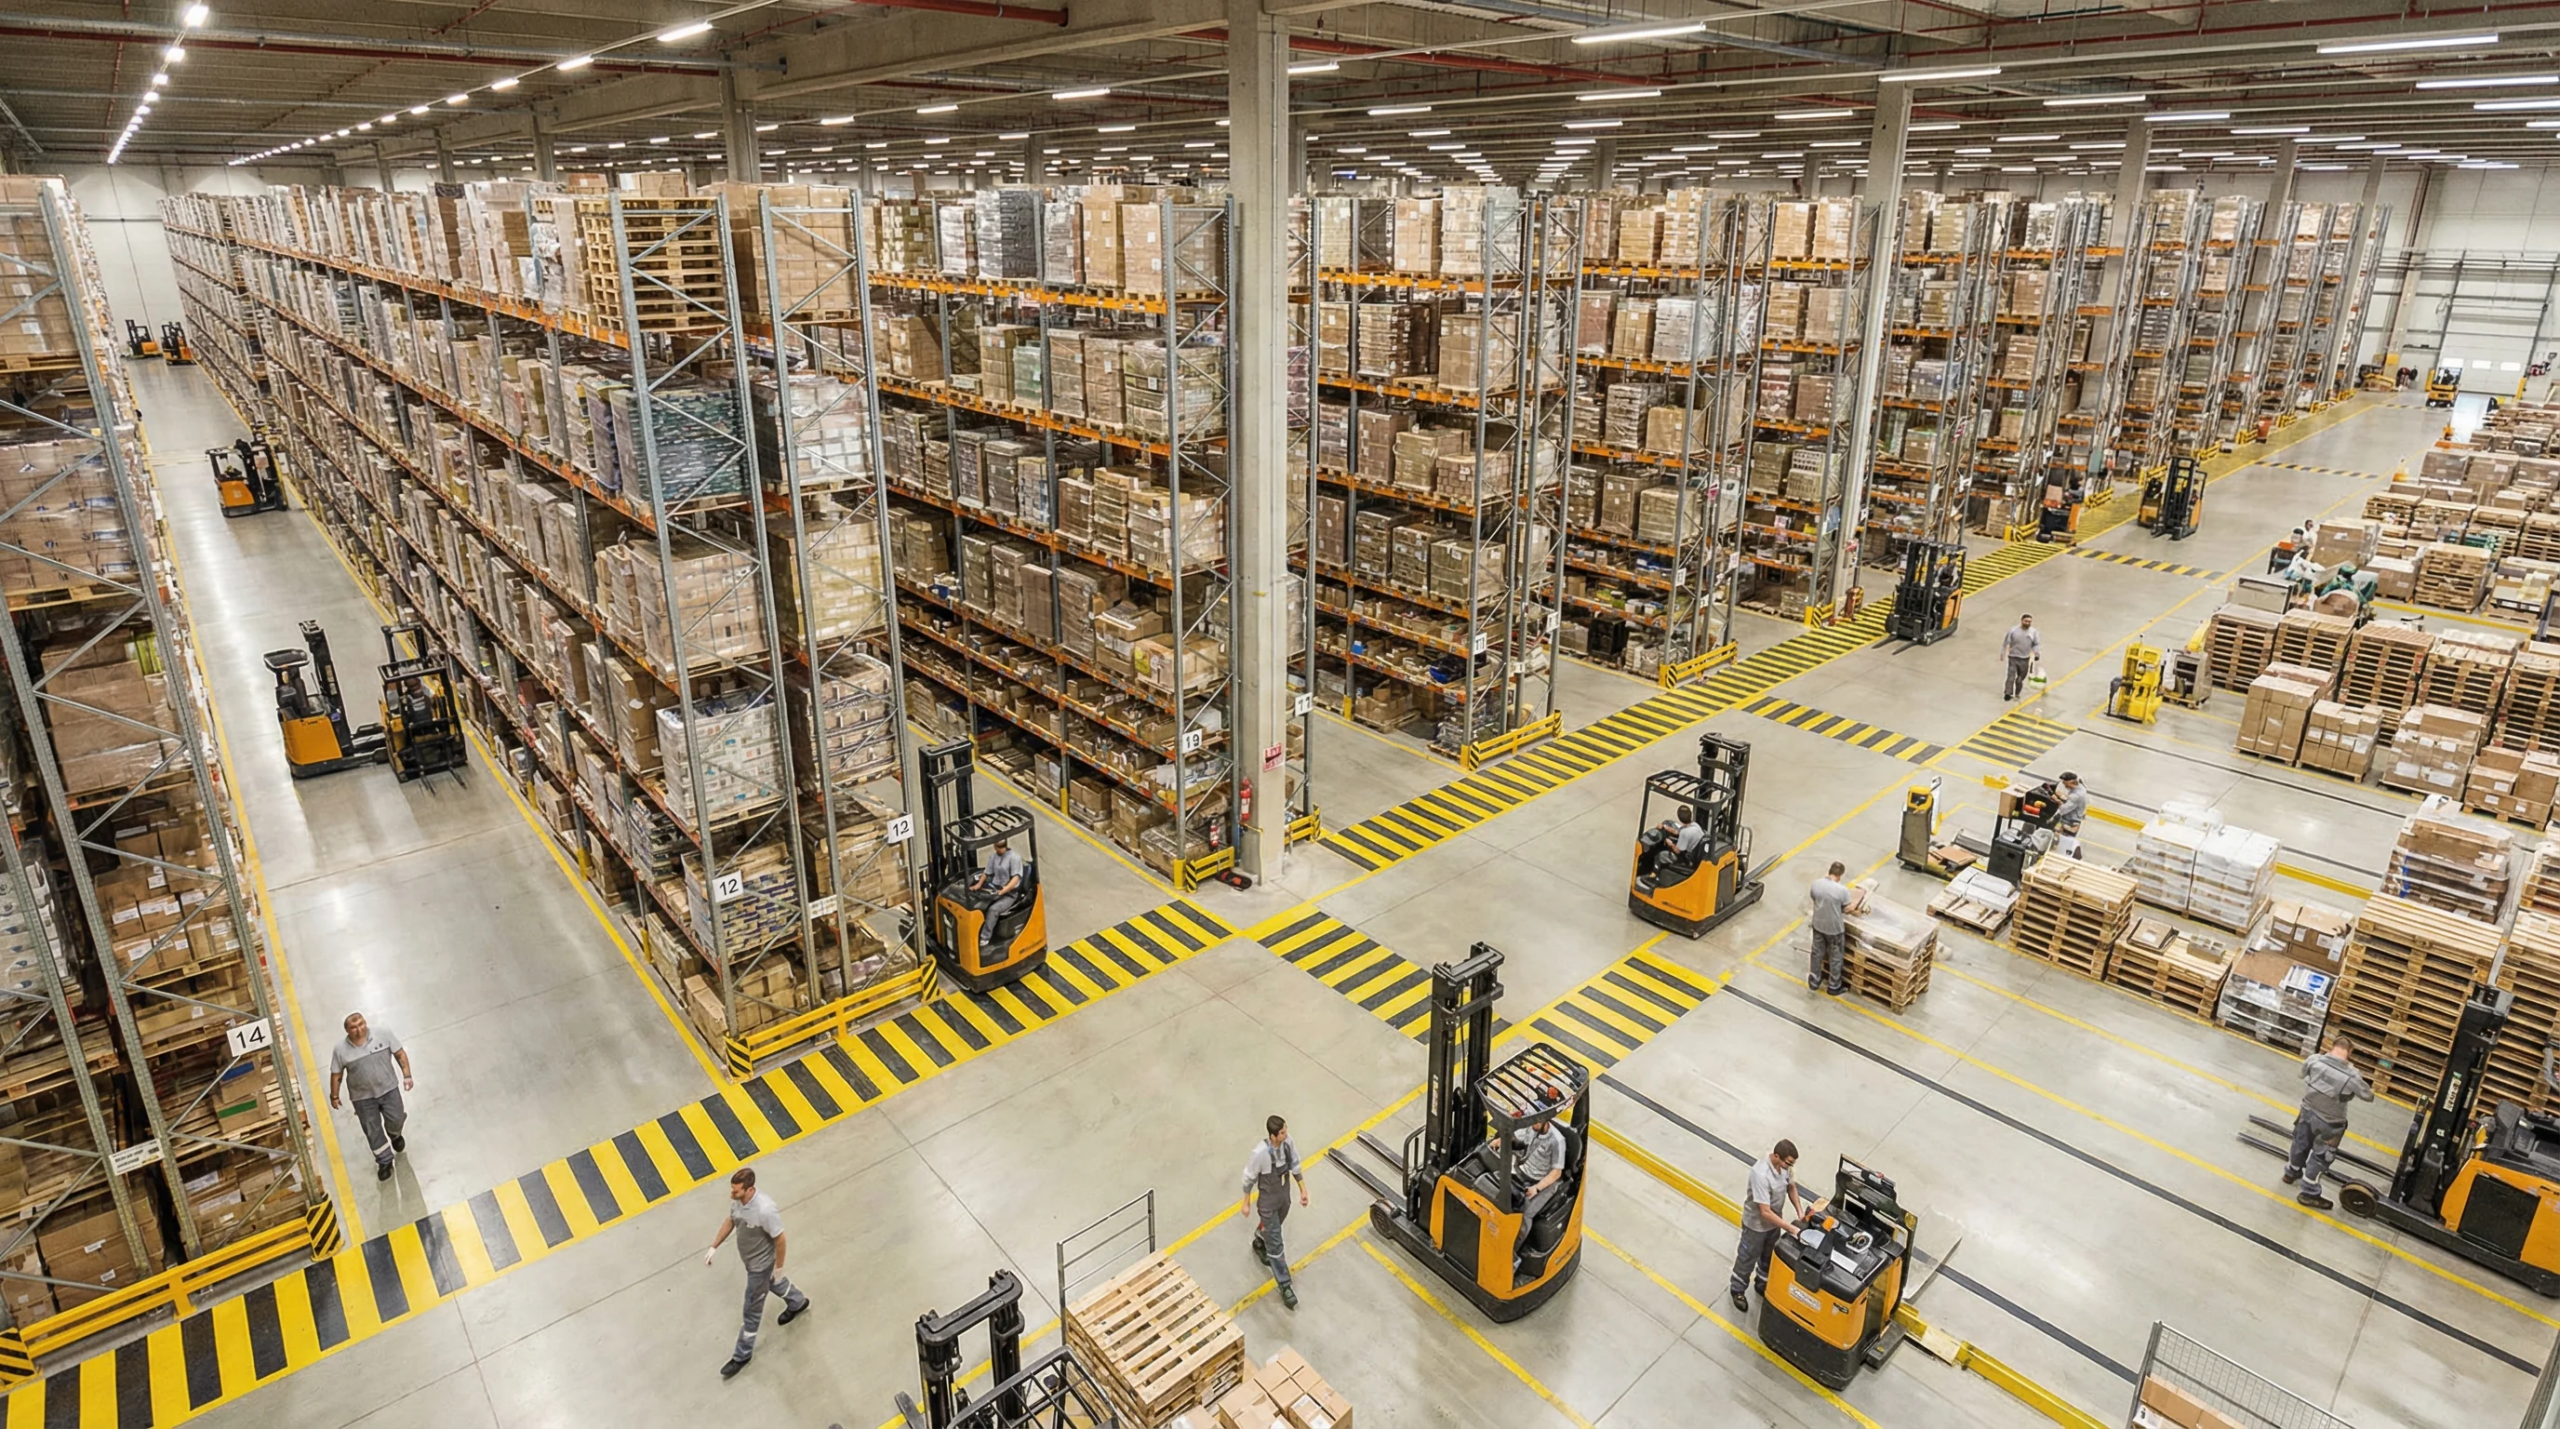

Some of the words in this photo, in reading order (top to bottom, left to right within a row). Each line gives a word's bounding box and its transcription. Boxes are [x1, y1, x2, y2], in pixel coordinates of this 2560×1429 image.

[892, 820, 910, 837] 12
[719, 878, 739, 896] 12
[236, 1026, 266, 1048] 14
